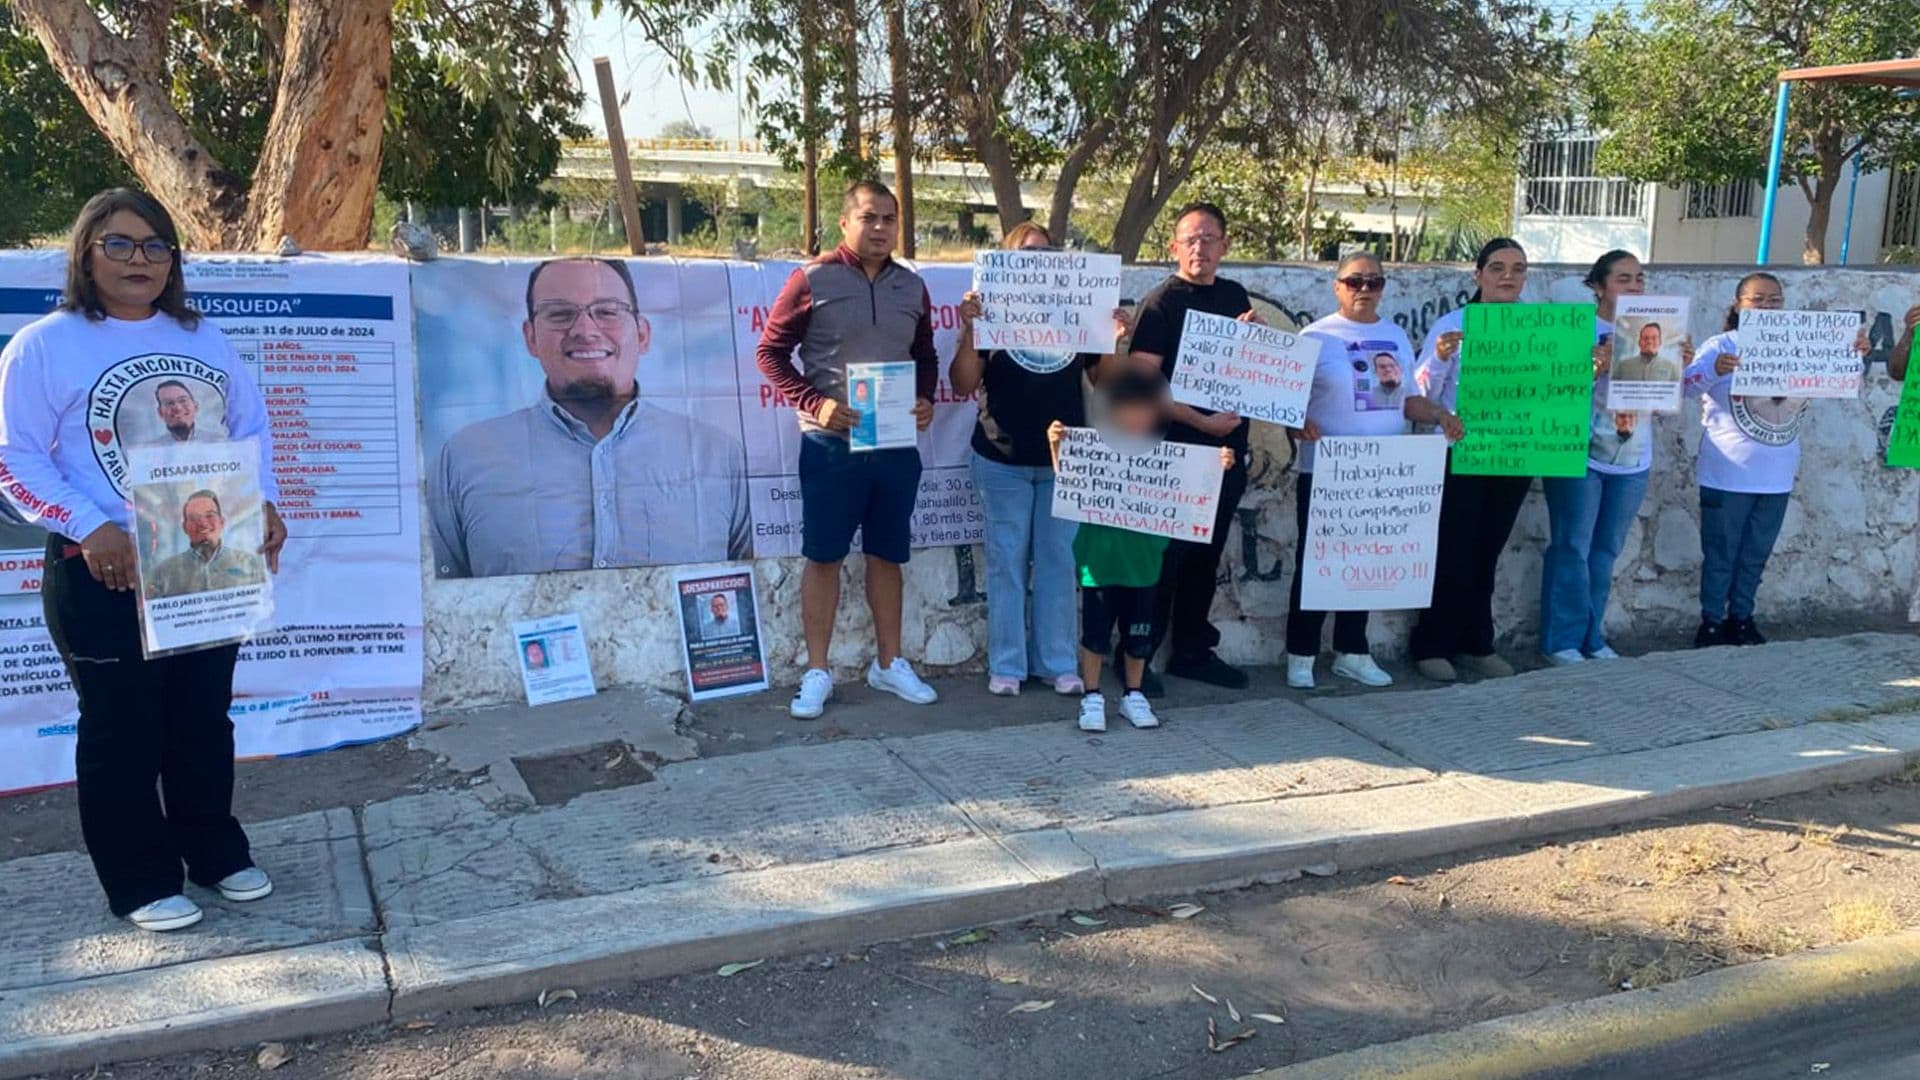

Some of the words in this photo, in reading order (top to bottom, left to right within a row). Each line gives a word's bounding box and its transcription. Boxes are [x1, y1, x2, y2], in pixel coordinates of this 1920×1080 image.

[1185, 311, 1239, 336] PABLO
[1741, 311, 1752, 327] 2
[262, 326, 276, 335] 31
[280, 325, 293, 335] de
[295, 326, 328, 336] JULIO
[331, 326, 345, 336] de
[347, 327, 376, 337] 2024
[1222, 344, 1234, 358] a
[1202, 361, 1216, 374] a
[93, 373, 129, 419] HASTA
[756, 522, 796, 537] Edad:
